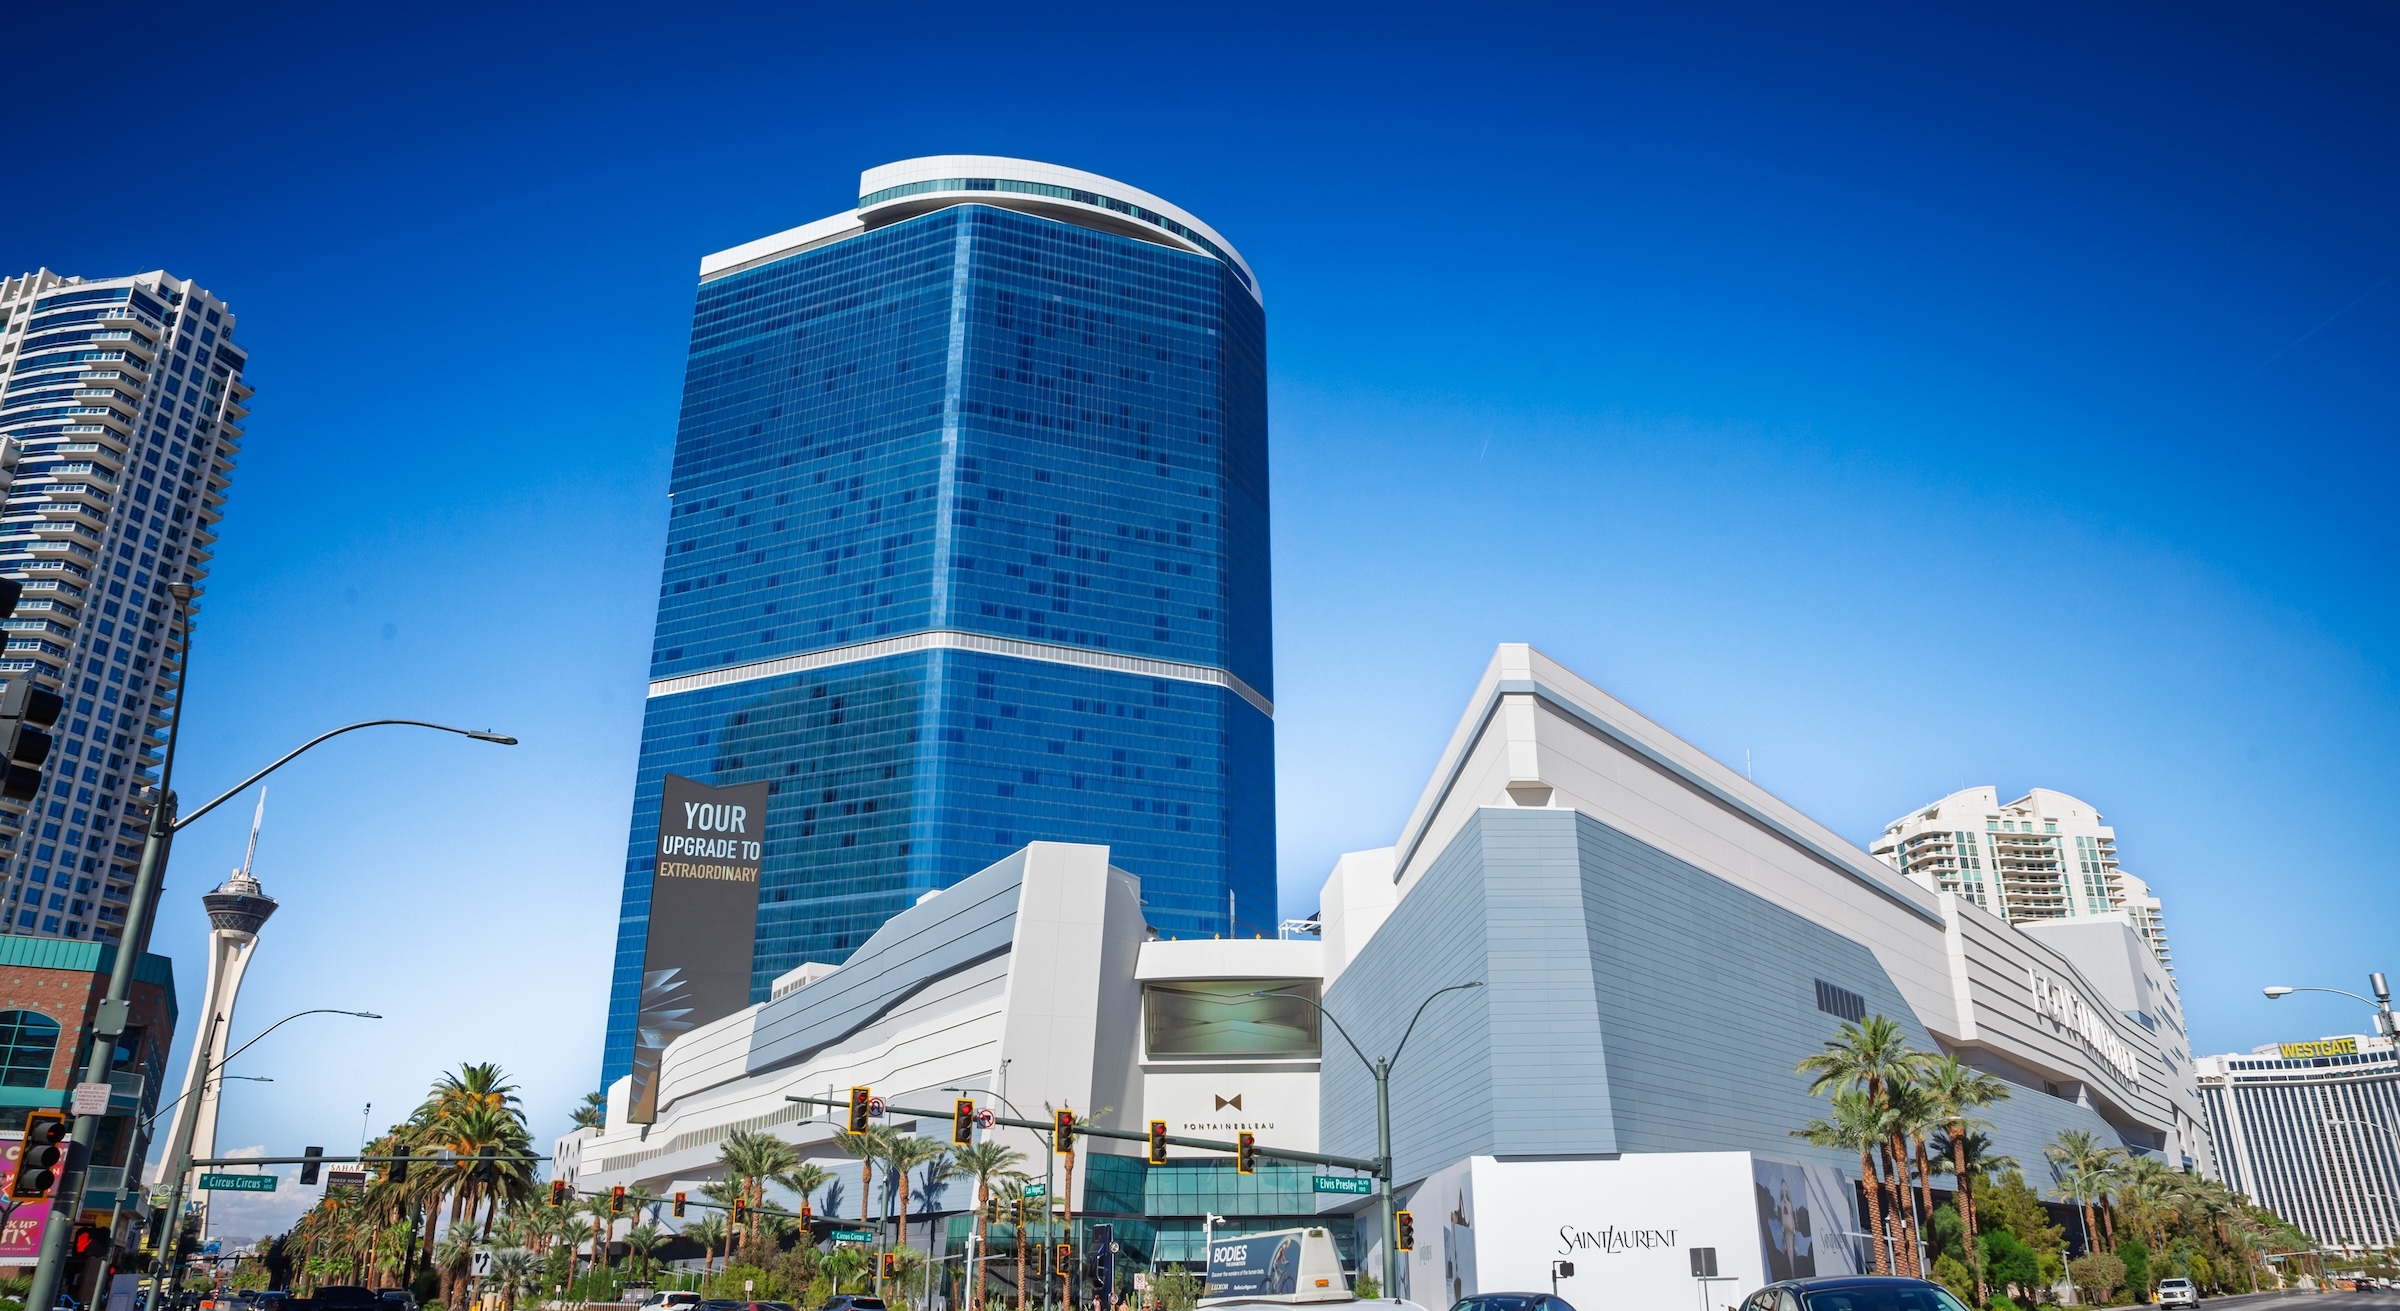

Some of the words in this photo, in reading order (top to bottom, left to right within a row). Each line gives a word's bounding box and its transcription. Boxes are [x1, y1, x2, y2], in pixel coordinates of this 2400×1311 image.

[684, 802, 747, 833] YOUR
[662, 835, 737, 859] UPGRADE
[741, 841, 761, 860] TO
[660, 862, 758, 882] EXTRAORDINARY
[2279, 1037, 2358, 1058] WESTGATE
[1184, 1122, 1275, 1131] FONTAINEBLEAU
[330, 1164, 363, 1172] SAHAR
[209, 1176, 235, 1188] Circus
[236, 1177, 261, 1189] Circus
[1320, 1178, 1335, 1189] Elvis
[1335, 1179, 1357, 1193] Presley
[836, 1232, 851, 1240] Circus
[851, 1233, 865, 1241] Circus
[1558, 1225, 1611, 1255] SAINT
[1607, 1225, 1679, 1254] LAURENT
[1214, 1245, 1248, 1263] BODIES
